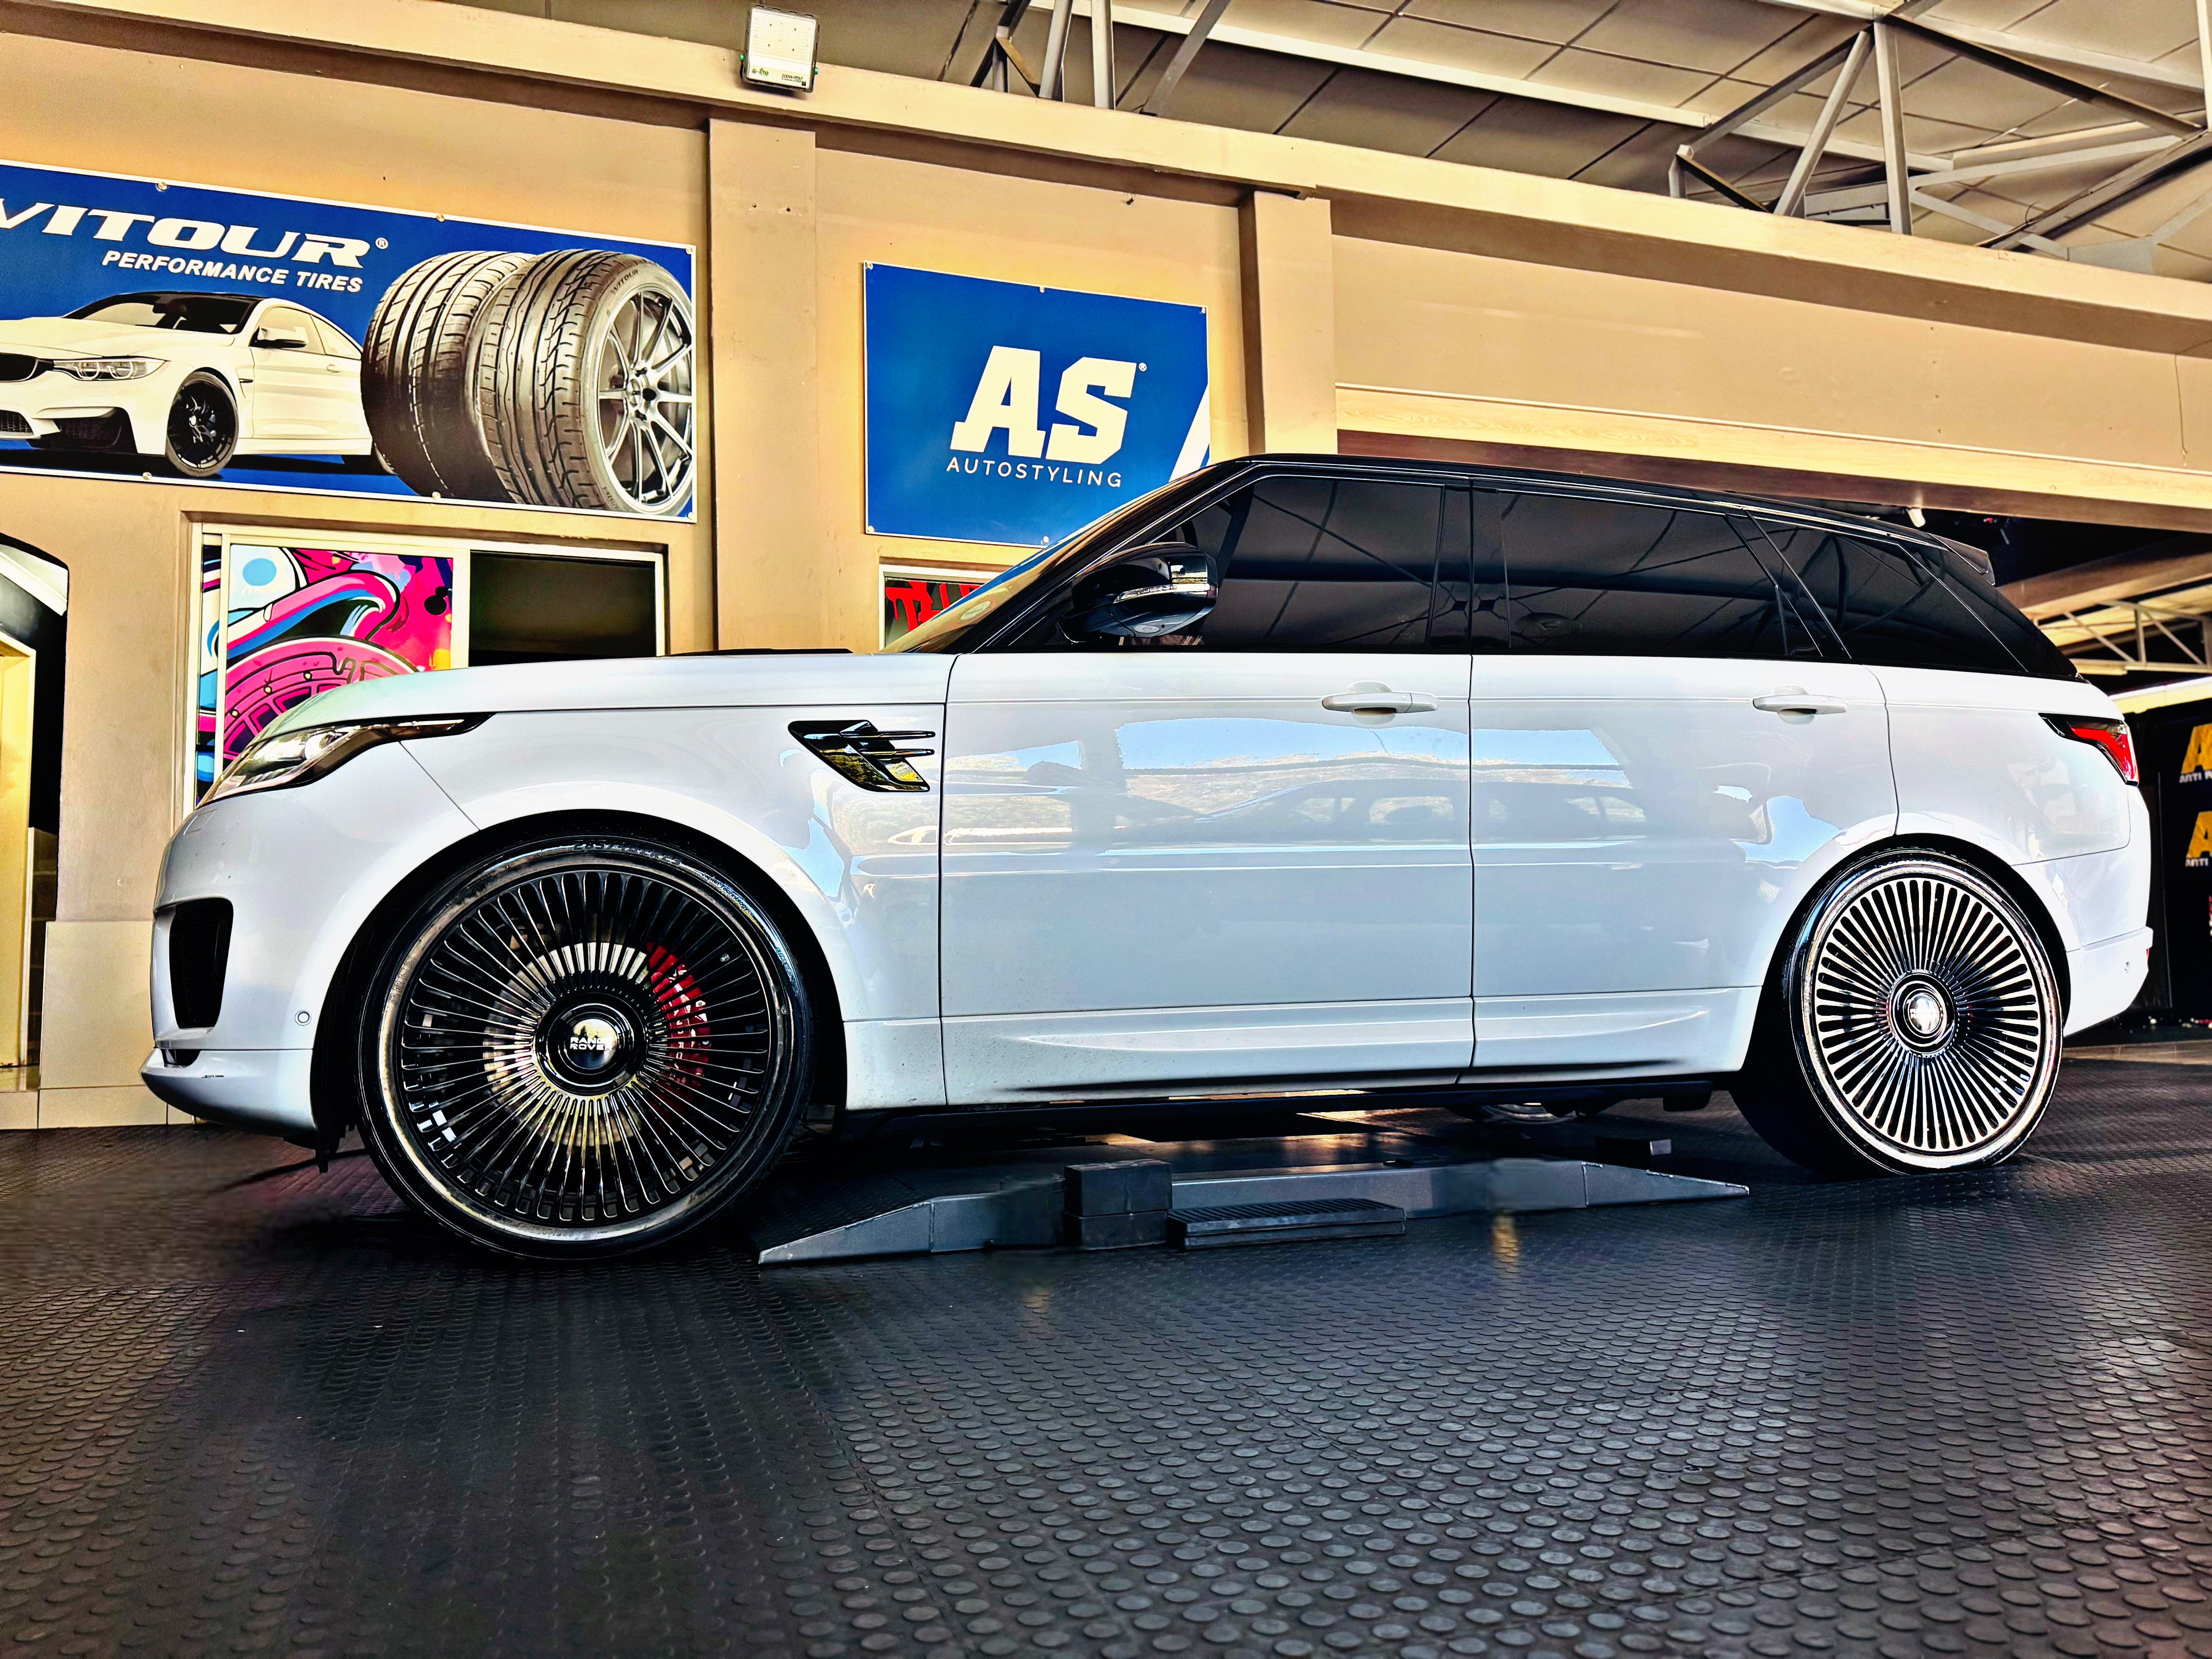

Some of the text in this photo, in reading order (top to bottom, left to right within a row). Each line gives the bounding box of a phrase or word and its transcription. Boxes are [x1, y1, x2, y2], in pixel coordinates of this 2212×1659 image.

[102, 250, 363, 293] PERFORMANCE TIRES
[613, 269, 639, 292] VITOUR
[950, 345, 1137, 465] AS
[946, 457, 1122, 488] AUTOSTYLING
